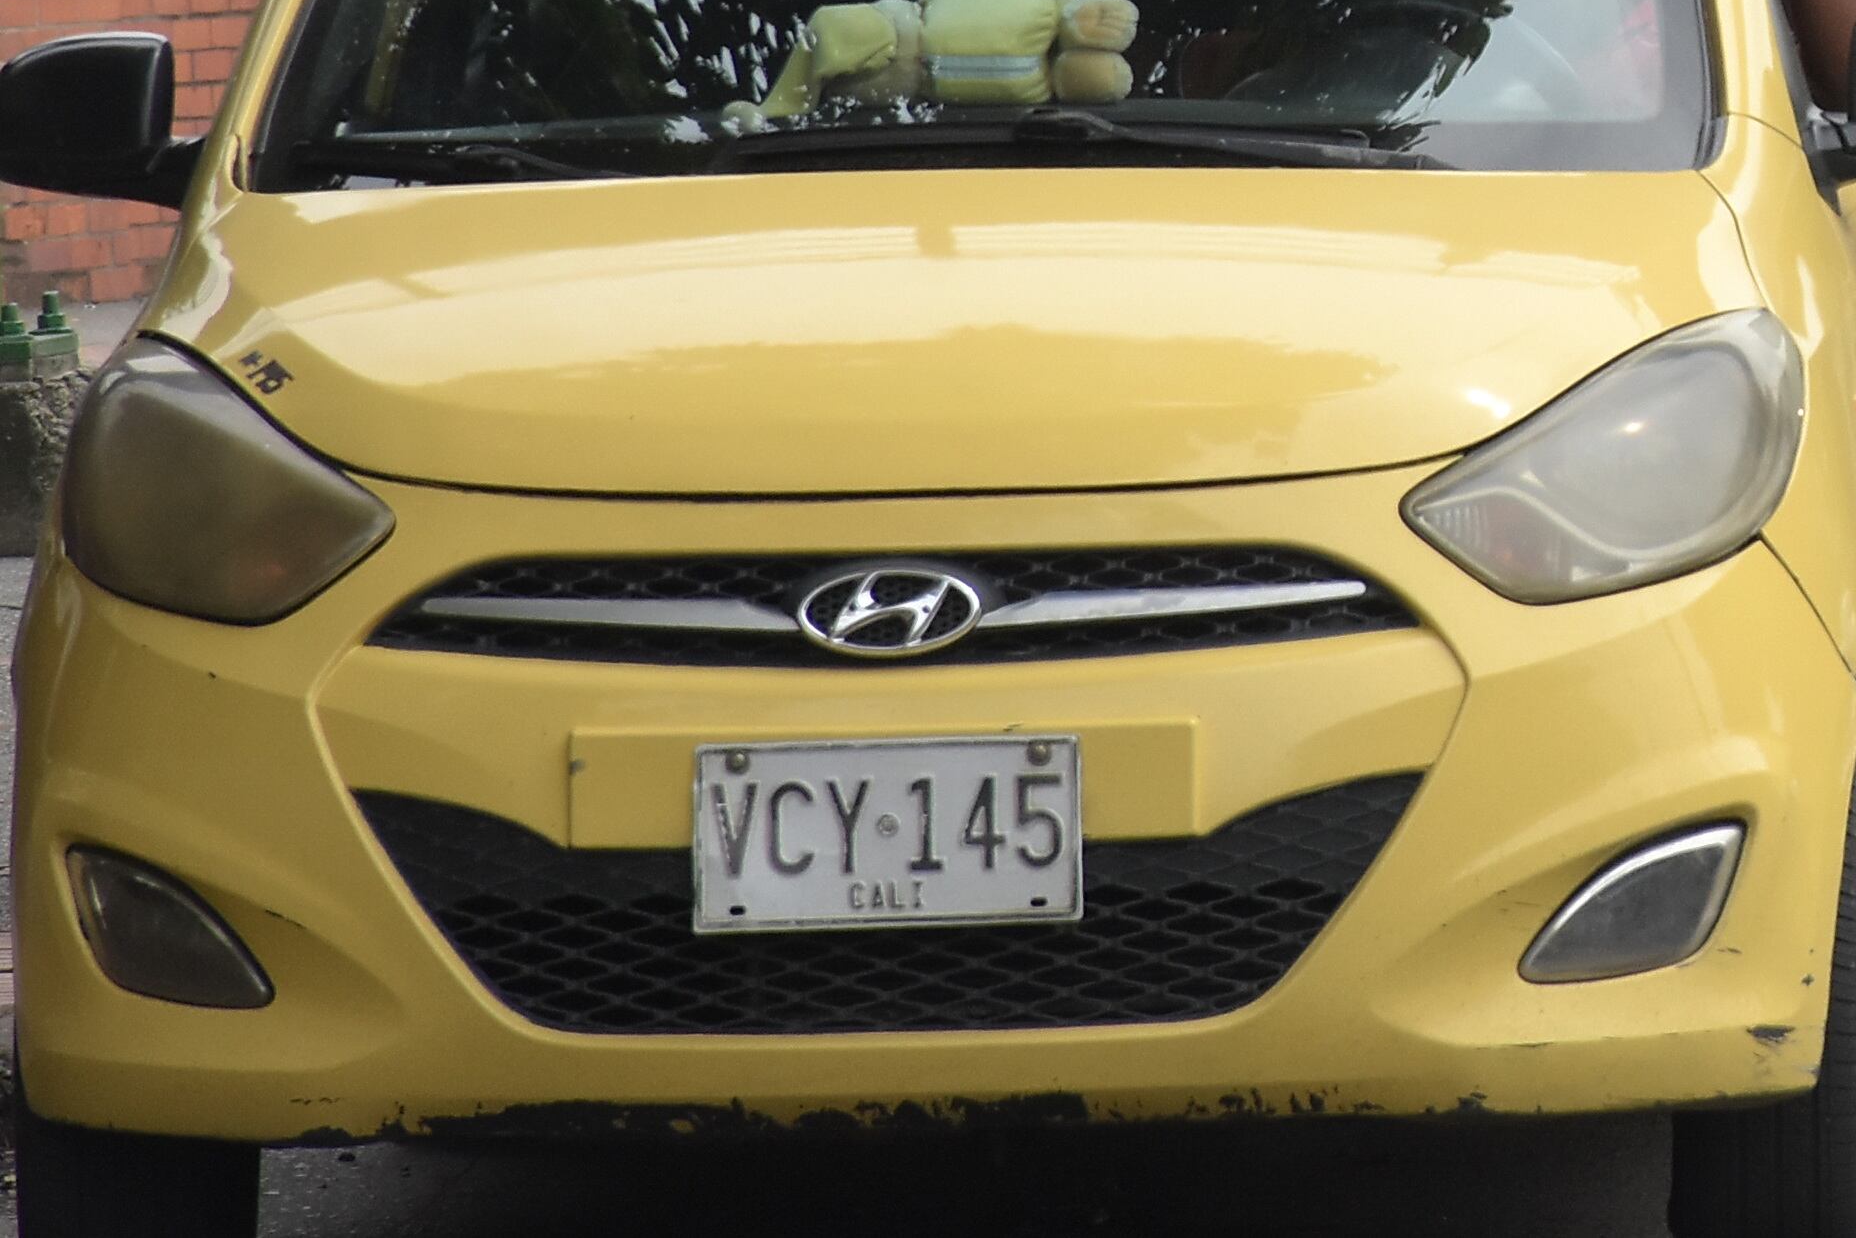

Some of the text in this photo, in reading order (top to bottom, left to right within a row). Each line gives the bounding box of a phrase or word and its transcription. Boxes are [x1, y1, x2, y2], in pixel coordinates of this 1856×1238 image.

[709, 773, 1065, 878] VCY 145
[849, 879, 927, 910] CALI
